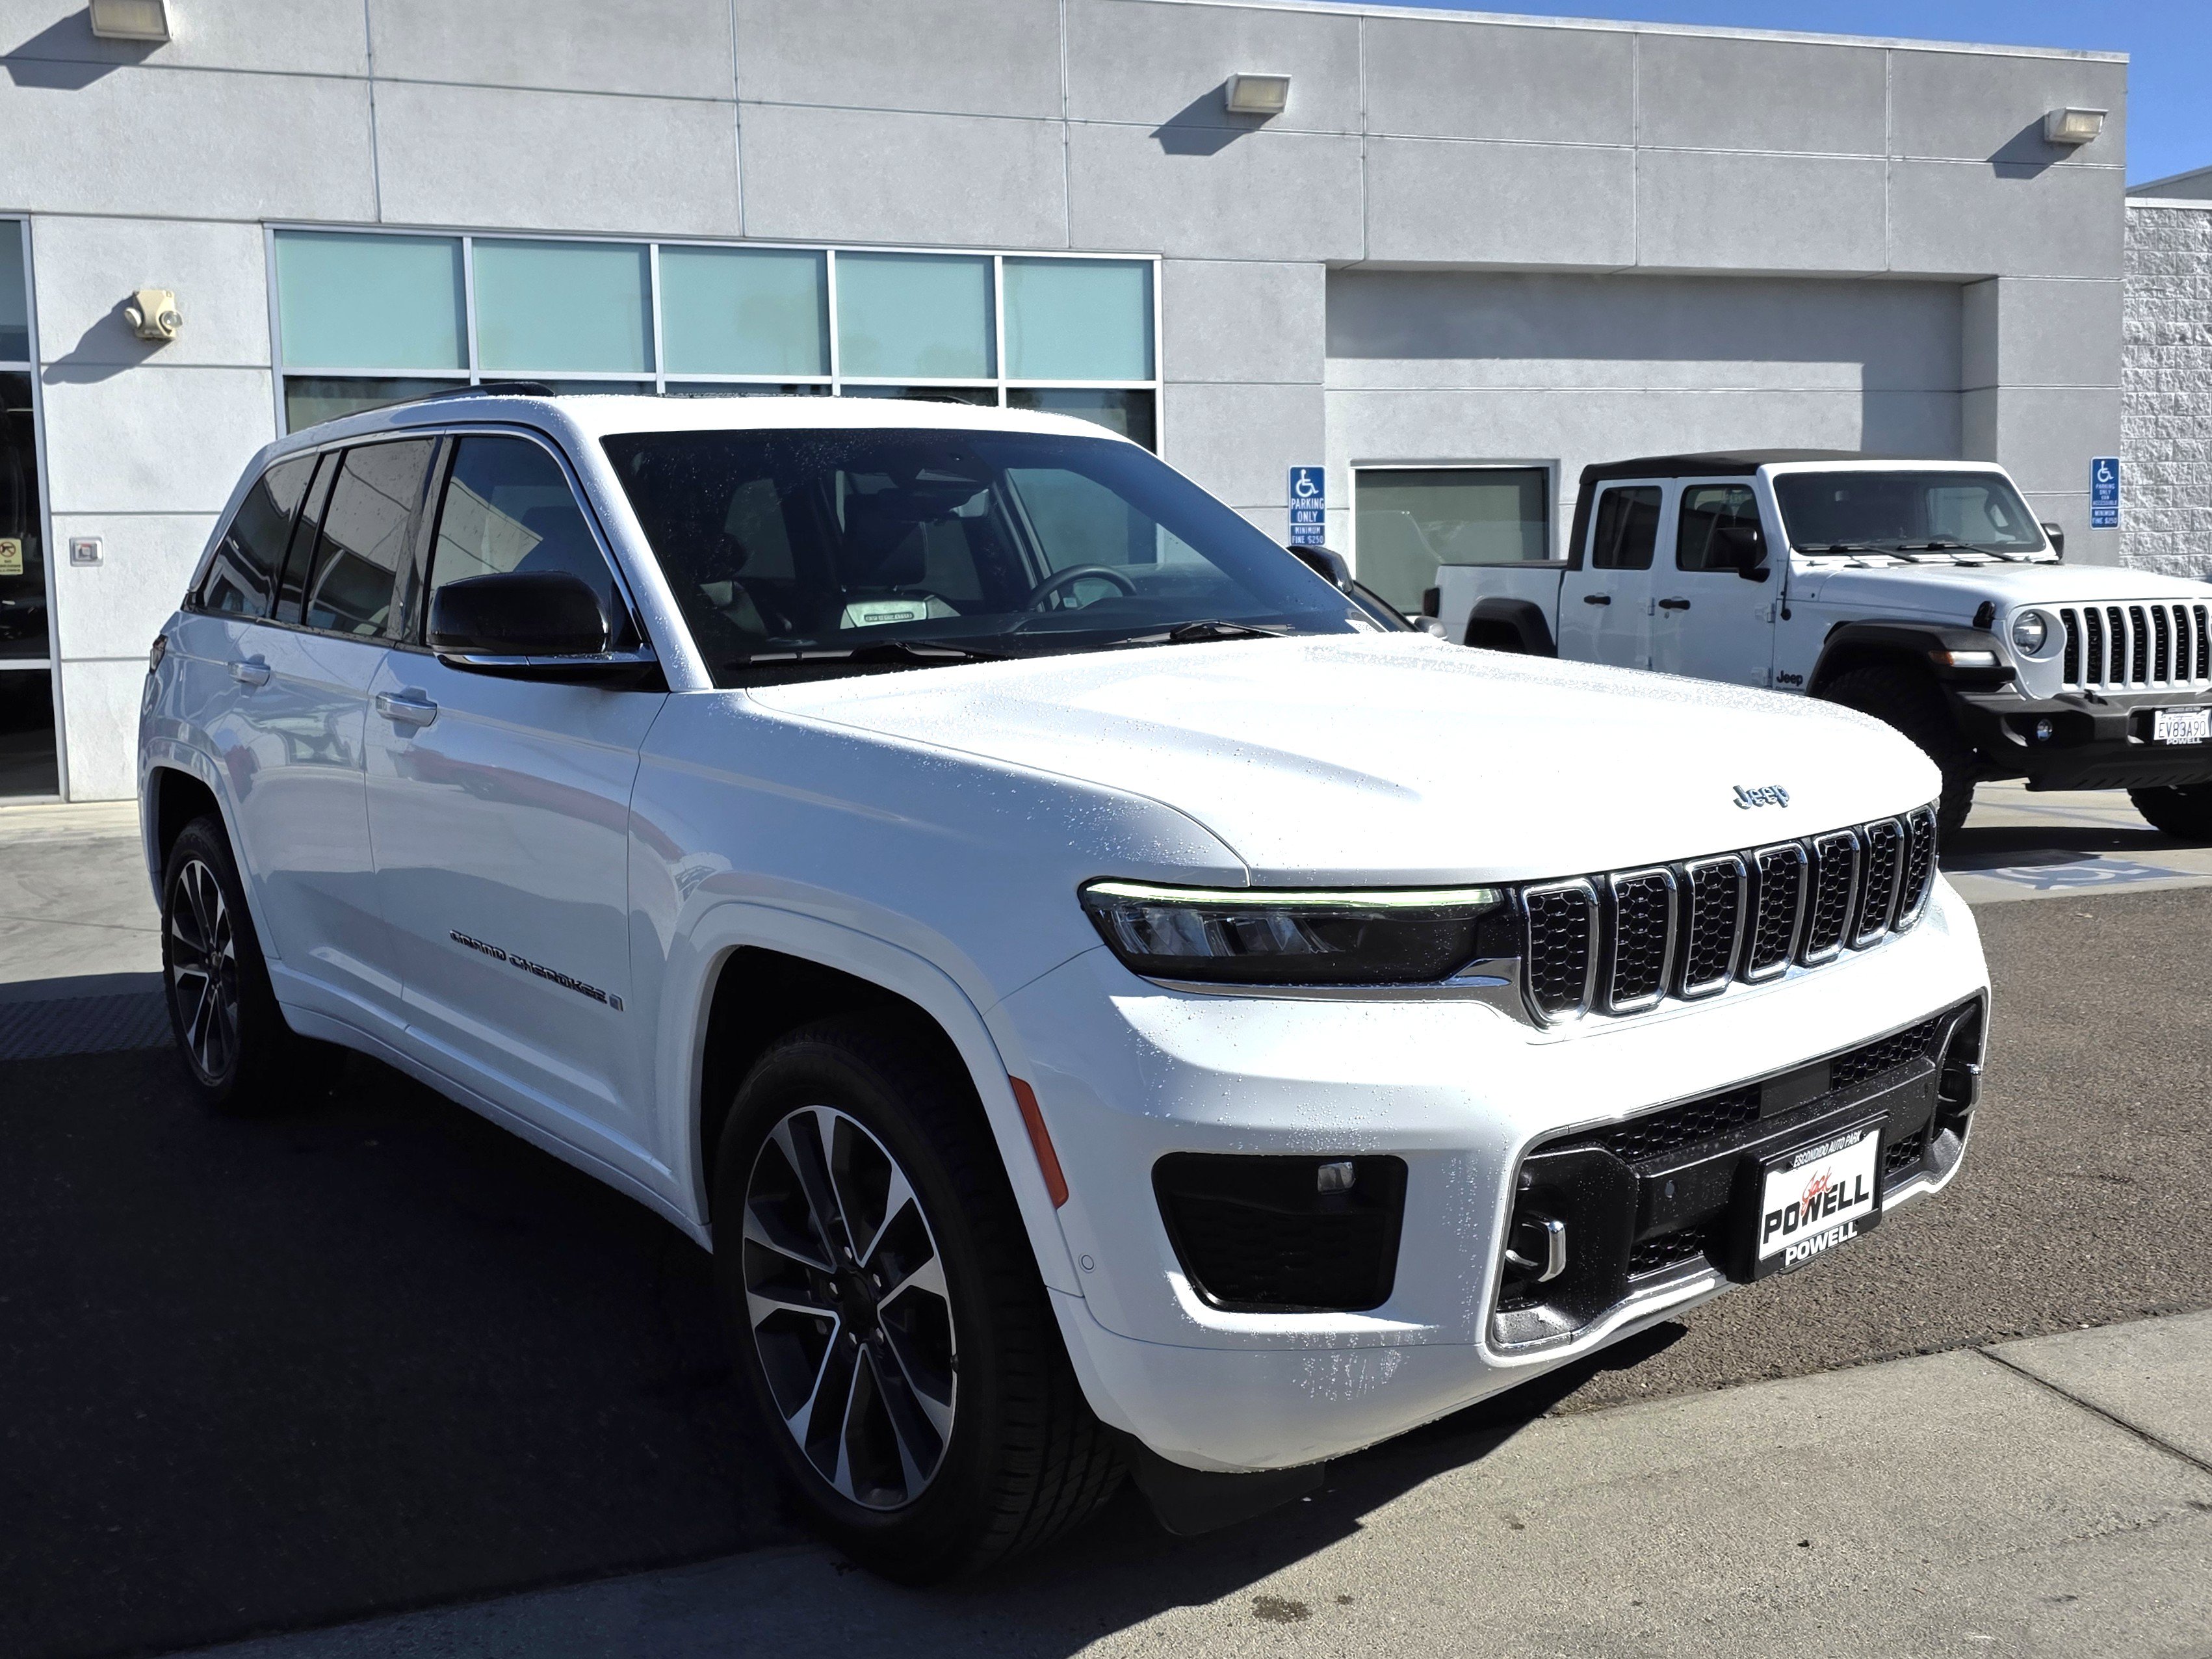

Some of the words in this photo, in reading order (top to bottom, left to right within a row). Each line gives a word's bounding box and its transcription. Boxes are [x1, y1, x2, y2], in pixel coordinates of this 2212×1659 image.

[1291, 498, 1324, 510] PARKING
[1297, 511, 1318, 522] ONLY
[1307, 535, 1324, 544] $250
[1776, 670, 1803, 686] Jeep
[2159, 721, 2205, 738] EV83A90
[1733, 785, 1789, 810] Jeep
[1793, 1143, 1829, 1168] ESCONDIDO
[1828, 1136, 1845, 1154] AUTO
[1844, 1130, 1862, 1147] PARK
[1801, 1166, 1833, 1216] Jack
[1763, 1174, 1869, 1244] POWELL
[1785, 1221, 1858, 1266] POWELL
